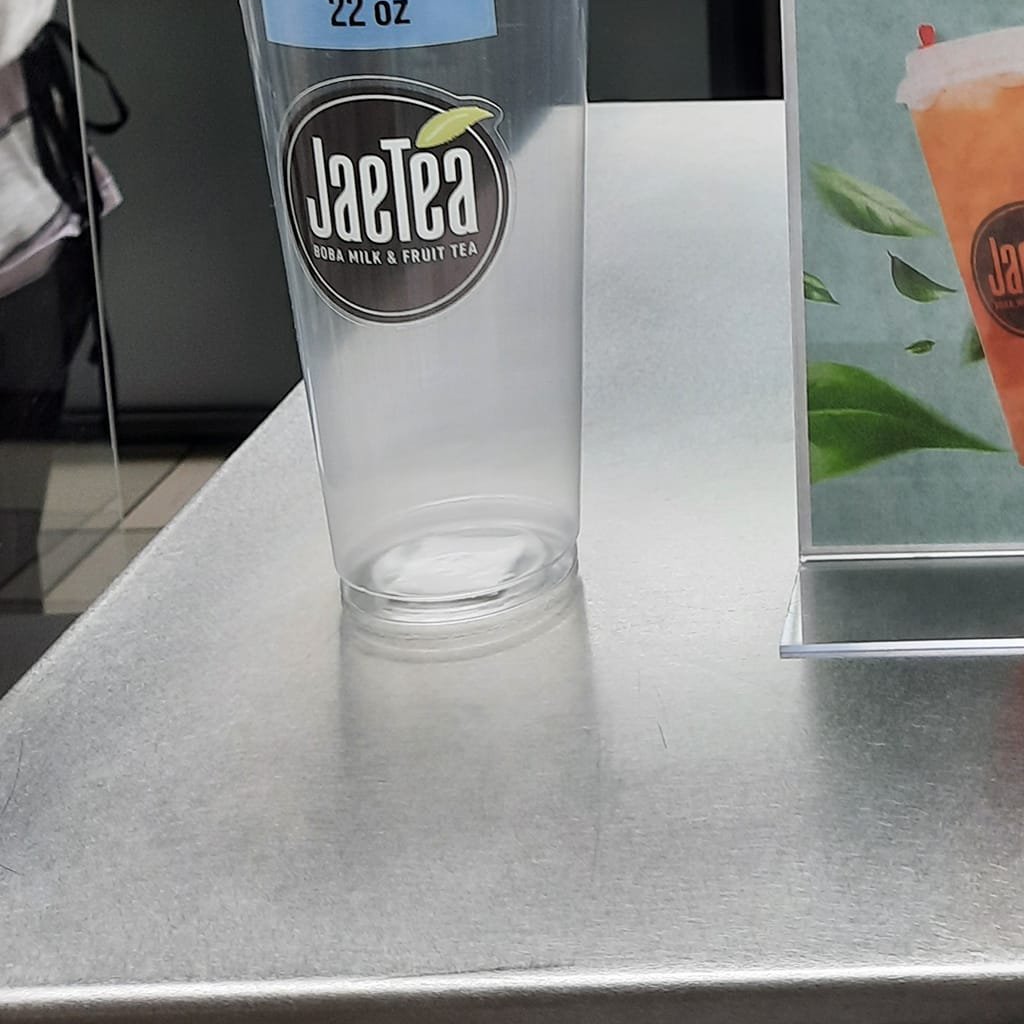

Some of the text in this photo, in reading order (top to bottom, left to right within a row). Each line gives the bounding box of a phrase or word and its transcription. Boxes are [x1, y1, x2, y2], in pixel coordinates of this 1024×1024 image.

[313, 241, 479, 265] BOBA MILK & FRUIT TEA
